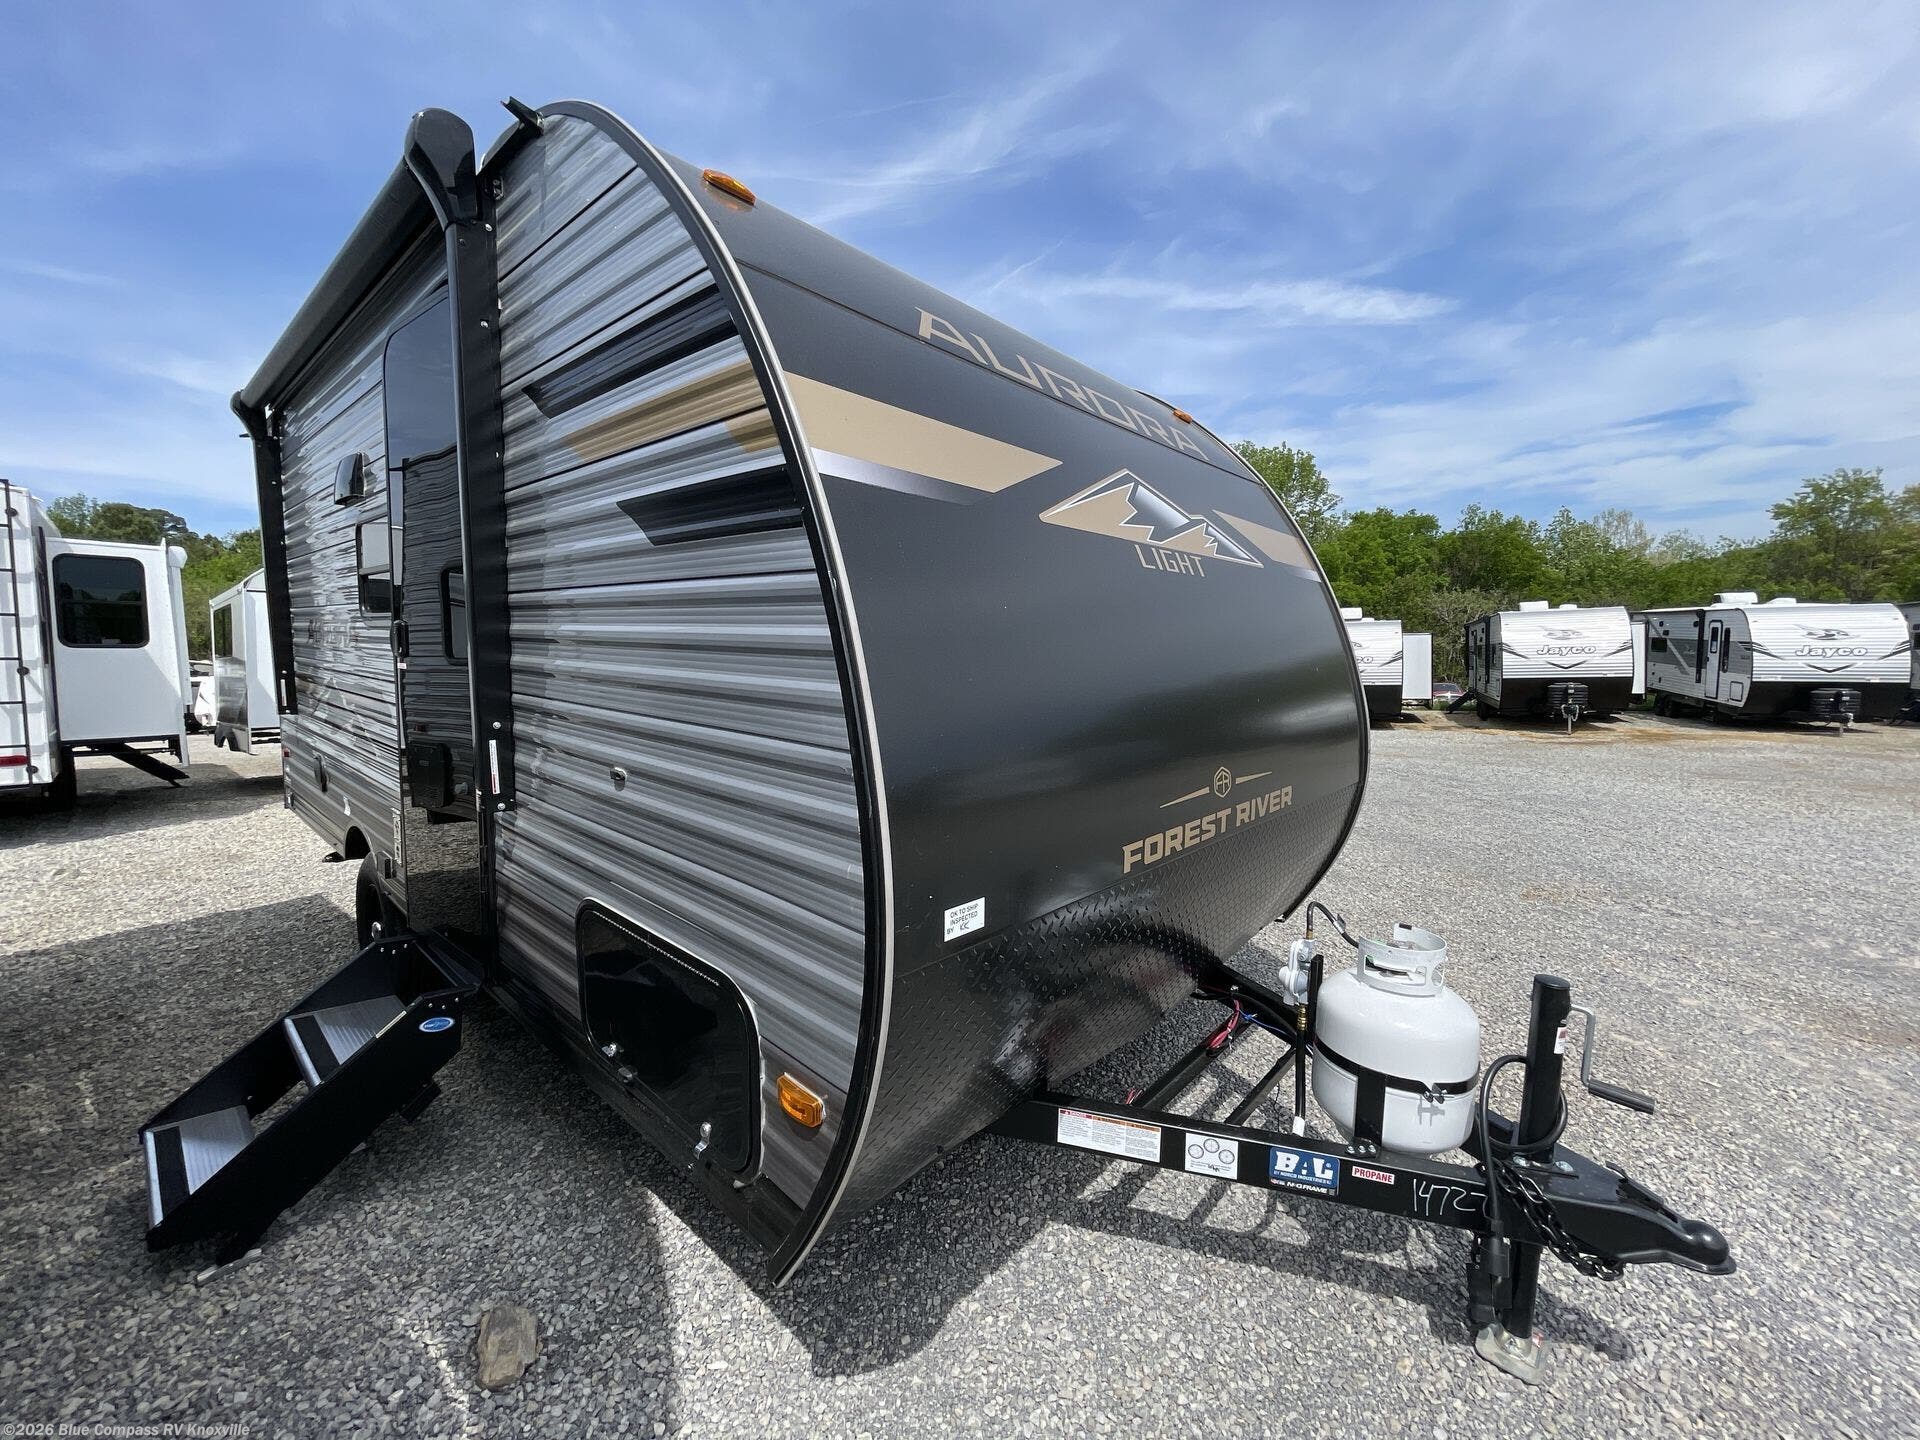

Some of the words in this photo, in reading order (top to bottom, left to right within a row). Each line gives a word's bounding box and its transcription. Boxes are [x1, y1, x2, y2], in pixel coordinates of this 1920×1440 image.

[915, 306, 1210, 461] AURORA
[1134, 544, 1206, 577] LIGHT
[1537, 644, 1597, 656] Jayco
[1795, 645, 1868, 658] Jayco
[1122, 808, 1232, 874] FOREST
[1236, 786, 1293, 827] RIVER
[950, 911, 958, 919] OK
[1354, 1167, 1393, 1183] PROPANE
